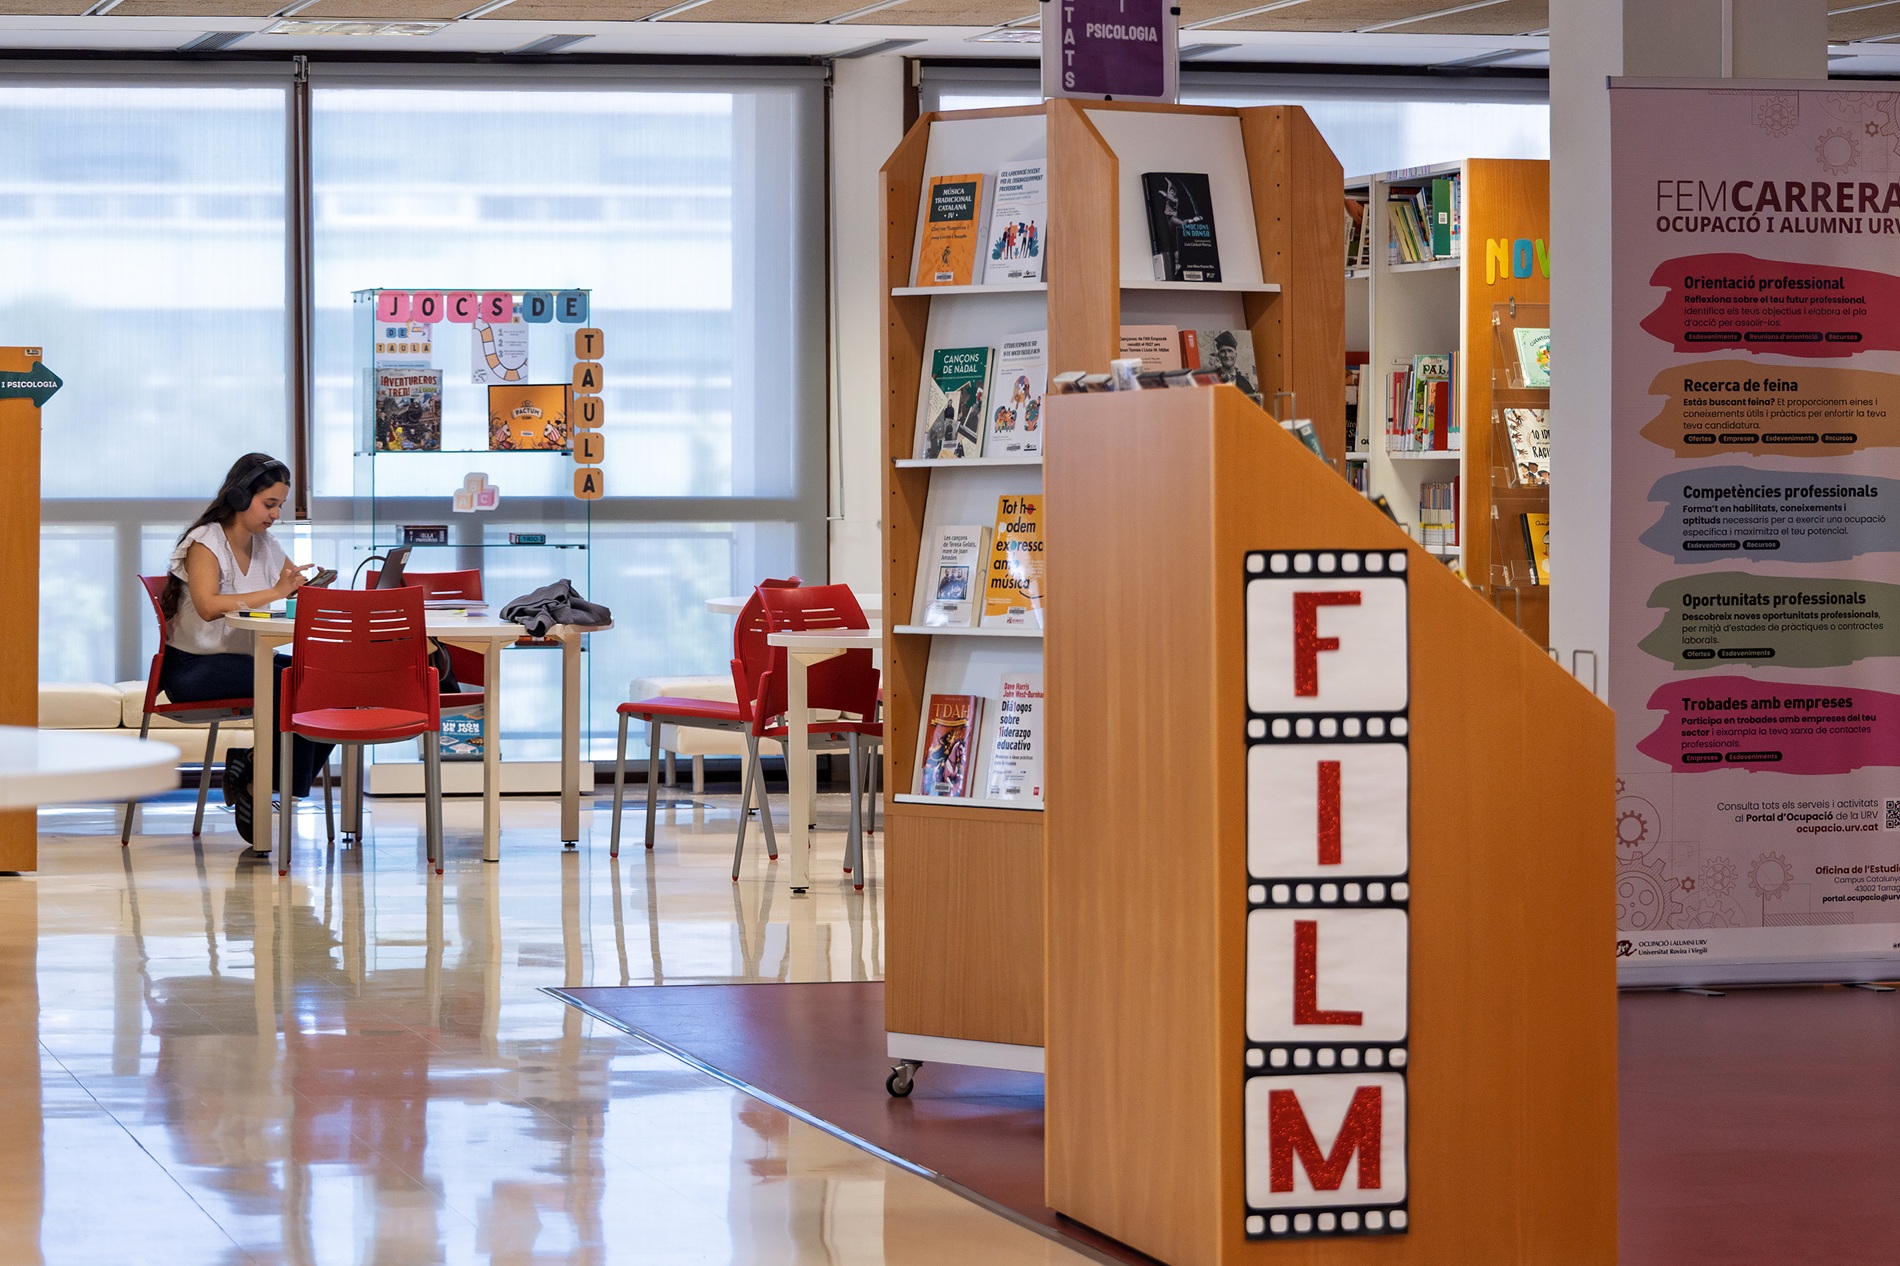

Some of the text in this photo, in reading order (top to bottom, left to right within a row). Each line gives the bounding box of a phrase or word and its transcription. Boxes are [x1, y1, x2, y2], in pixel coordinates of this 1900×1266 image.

[1086, 23, 1157, 41] PSICOLOGIA
[1064, 0, 1075, 88] TATS
[938, 203, 966, 211] CATALANA
[1656, 212, 1760, 233] OCUPACIÓ
[1767, 217, 1774, 233] I
[1780, 217, 1862, 233] ALUMNI
[1684, 275, 1844, 292] Orientació professional
[390, 298, 577, 316] JOCS DE
[378, 344, 429, 352] TAULA
[944, 354, 979, 365] CANÇONS
[943, 364, 977, 374] DE NADAL
[1423, 364, 1448, 374] PAL
[1684, 379, 1798, 391] Recerca de feina
[1684, 398, 1707, 406] Estàs
[1709, 398, 1746, 406] buscant
[1748, 398, 1775, 406] feina?
[1787, 398, 1847, 408] proporcionem
[1850, 398, 1873, 406] eines
[581, 335, 596, 493] TAULA
[1683, 410, 1744, 418] coneixements
[1748, 409, 1763, 417] útils
[1771, 410, 1806, 419] pràctics
[1808, 411, 1822, 419] per
[1824, 409, 1853, 417] enfortir
[1532, 446, 1550, 459] RACI
[1683, 484, 1878, 500] Competències professionals
[1003, 499, 1017, 514] Tot
[1733, 504, 1778, 513] habilitats,
[1780, 504, 1842, 512] coneixements
[1683, 516, 1721, 526] aptituds
[1723, 516, 1768, 524] necessaris
[1771, 517, 1785, 525] per
[1845, 515, 1885, 525] ocupació
[1683, 528, 1727, 538] específica
[1808, 527, 1848, 537] potencial.
[991, 575, 1030, 588] música
[1682, 592, 1866, 609] Oportunitats professionals
[1682, 611, 1880, 621] Descobreix noves oportunitats professionals,
[1682, 625, 1696, 634] per
[1699, 624, 1721, 633] mitjà
[1768, 623, 1779, 631] de
[1782, 623, 1828, 633] pràctiques
[1838, 622, 1883, 630] contractes
[1682, 636, 1719, 644] laborals.
[1002, 701, 1032, 714] Diálogos
[1682, 697, 1852, 711] Trobades amb empreses
[933, 704, 971, 719] TDAH
[1000, 715, 1019, 725] sobre
[999, 727, 1031, 740] liderazgo
[997, 740, 1031, 750] educativo
[1717, 802, 1759, 811] Consulta
[1762, 801, 1779, 809] tots
[1782, 801, 1795, 809] els
[1797, 800, 1829, 808] serveis
[1837, 799, 1878, 807] activitats
[1746, 813, 1775, 822] Portal
[1836, 812, 1848, 820] de
[1850, 811, 1858, 819] la
[1861, 811, 1878, 819] URV
[1797, 823, 1878, 835] ocupacio.urv.cat
[1816, 866, 1849, 874] Oficina
[1852, 865, 1862, 874] de
[1834, 876, 1864, 884] Campus
[1269, 591, 1382, 1194] FILM
[1639, 948, 1668, 956] Universitat
